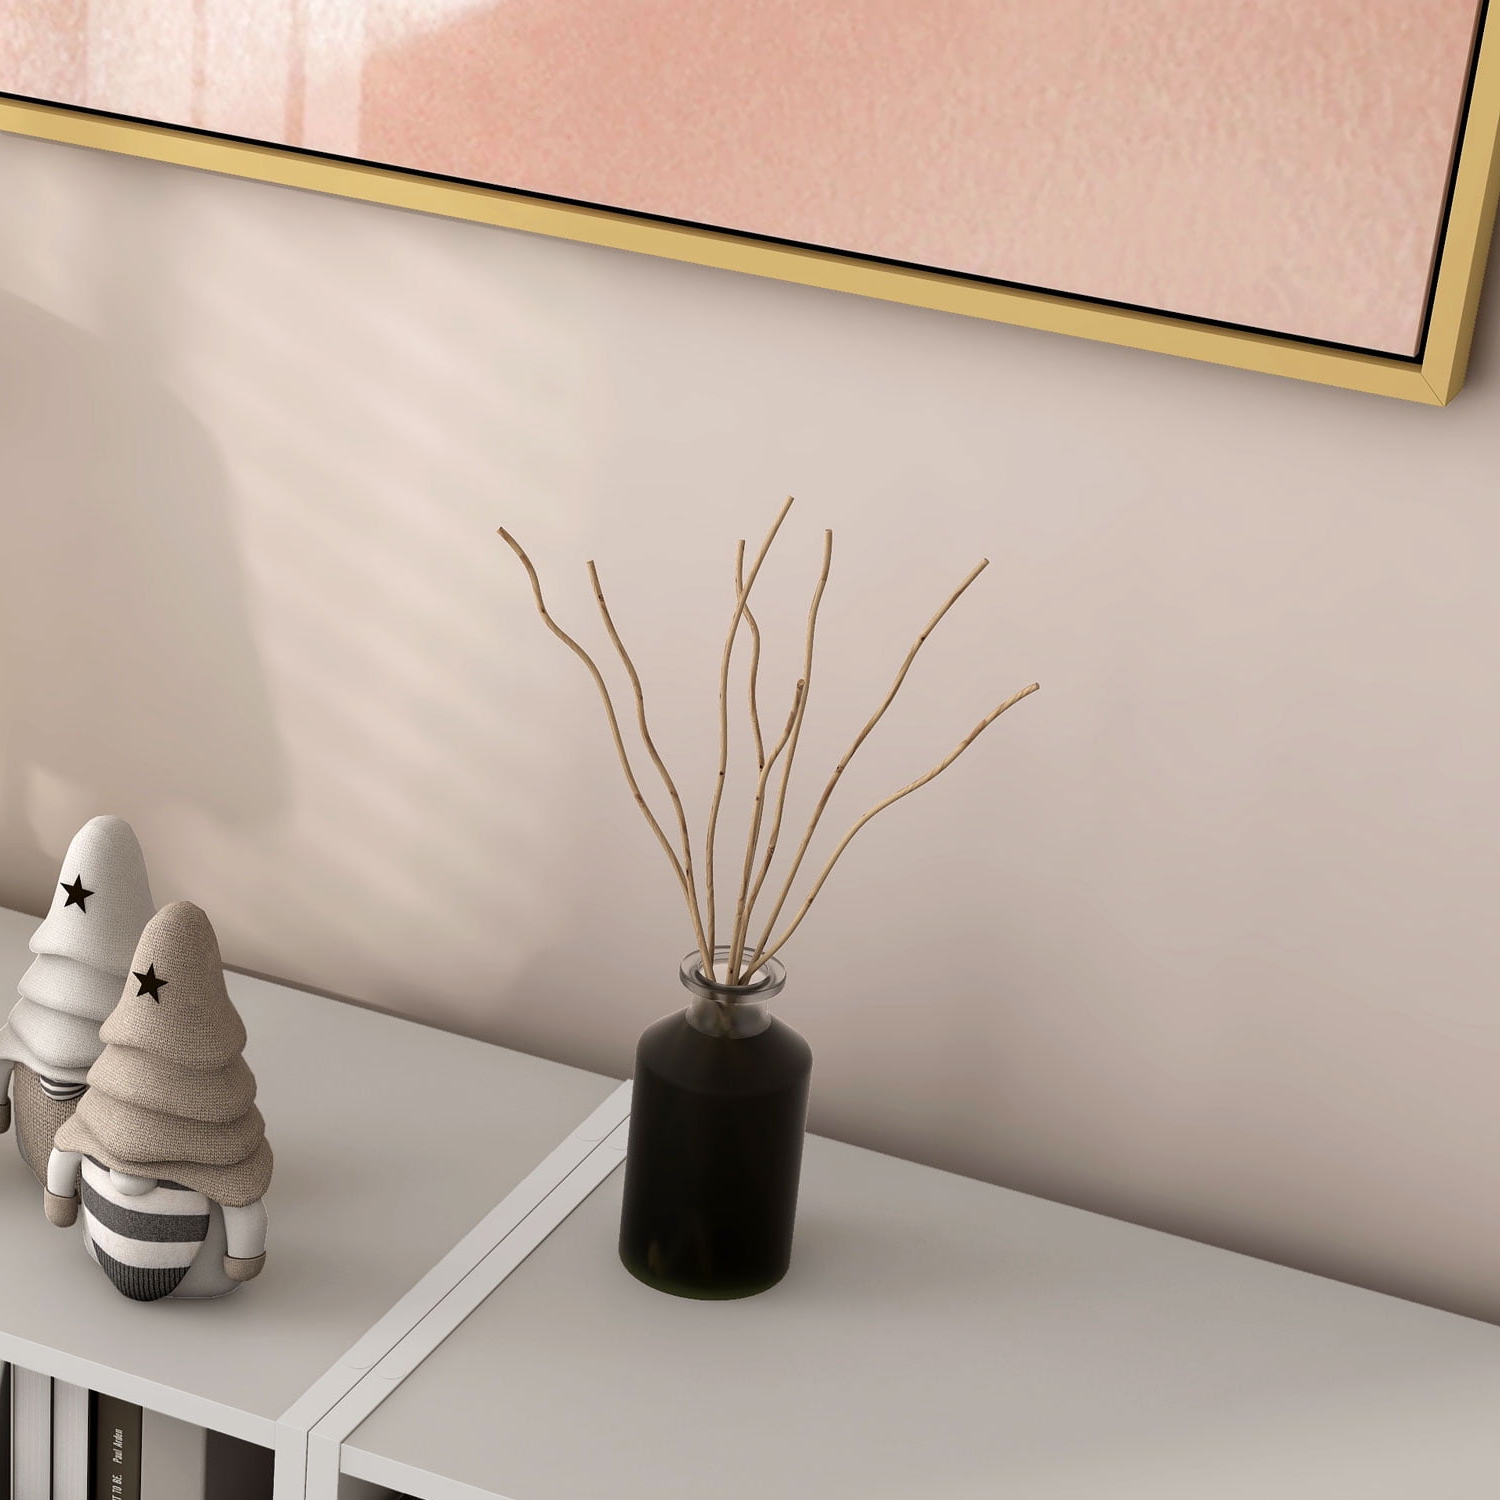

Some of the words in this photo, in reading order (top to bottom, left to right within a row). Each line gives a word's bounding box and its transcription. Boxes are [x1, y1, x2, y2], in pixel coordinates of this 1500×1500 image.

[112, 1428, 123, 1448] Arden
[112, 1448, 122, 1464] Paul
[112, 1485, 122, 1494] TO
